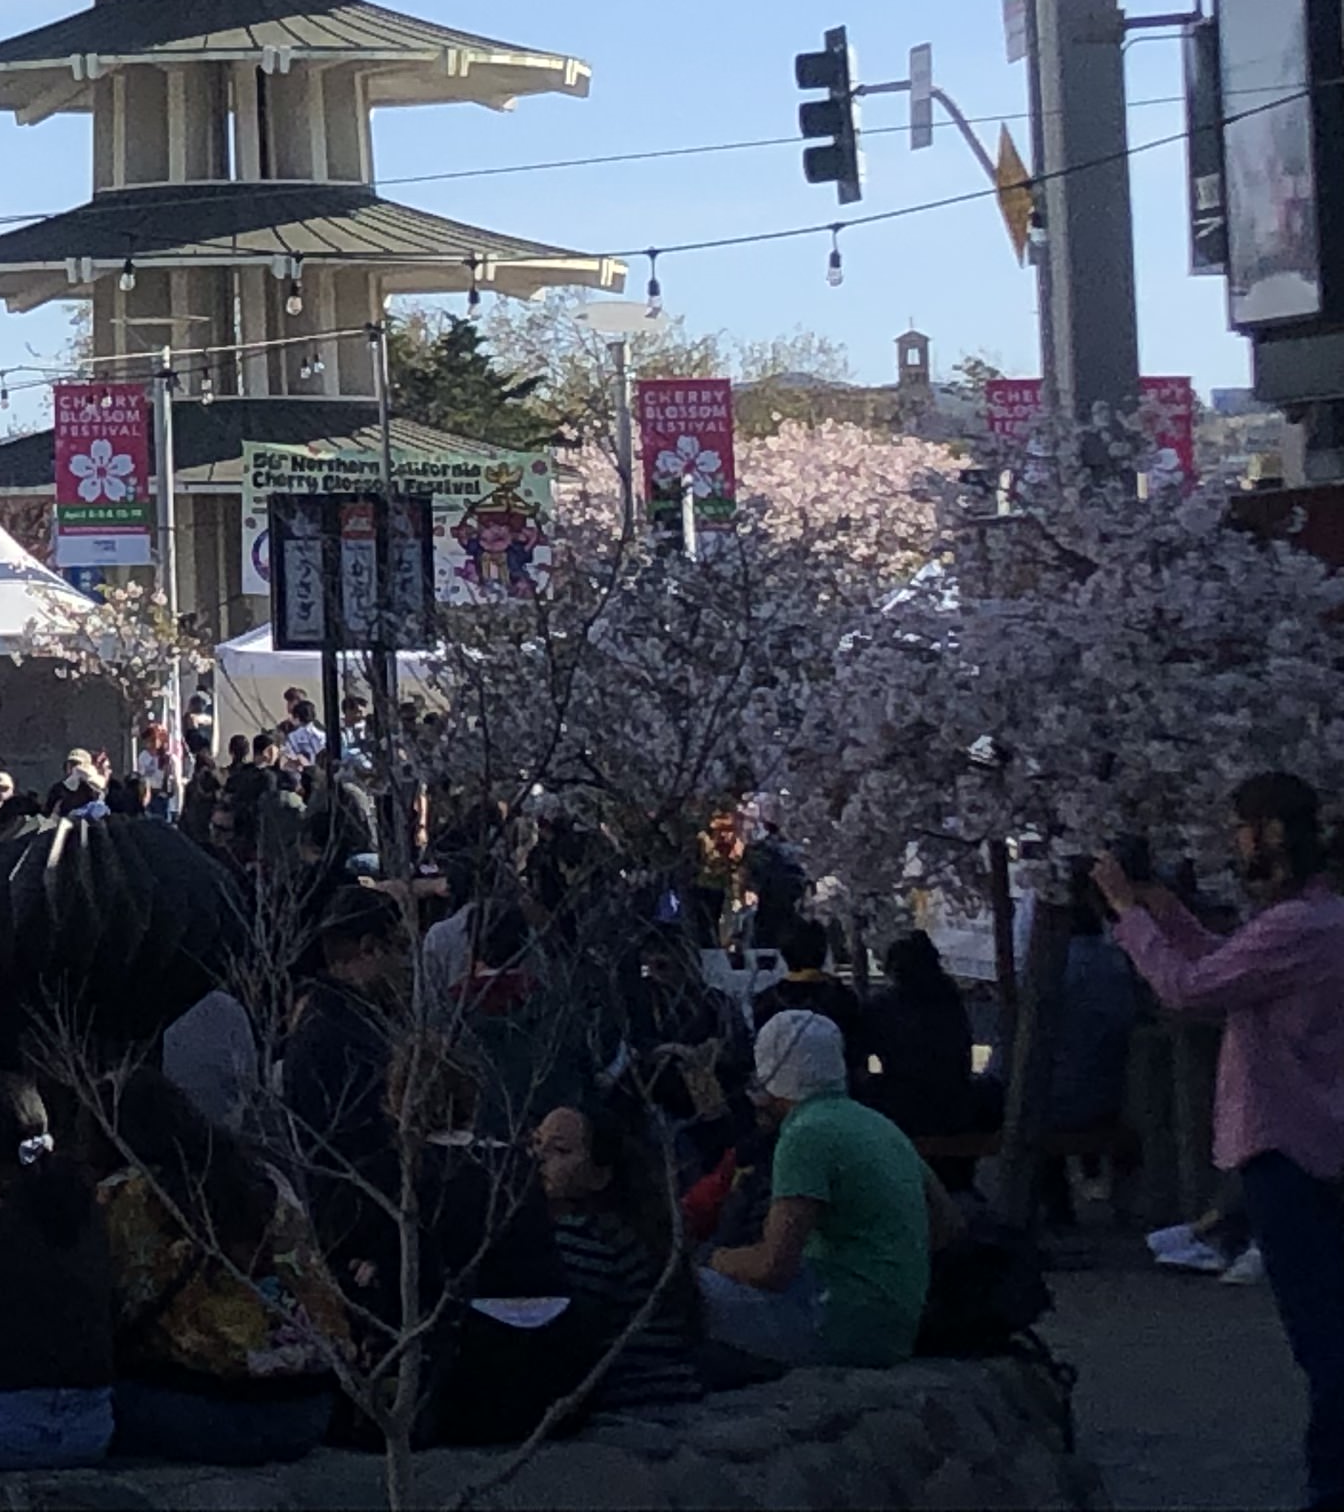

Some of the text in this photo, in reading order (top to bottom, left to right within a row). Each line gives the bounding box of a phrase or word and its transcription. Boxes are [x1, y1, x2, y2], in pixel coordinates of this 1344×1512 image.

[60, 396, 139, 409] CHRY
[644, 391, 726, 404] CHERRY
[61, 410, 141, 423] BLOSSOM
[645, 406, 727, 419] BLOSSOM
[61, 424, 142, 437] FESTIVAL
[646, 421, 727, 433] FESTIVAL
[291, 454, 380, 473] Northern
[253, 471, 318, 493] Cherry
